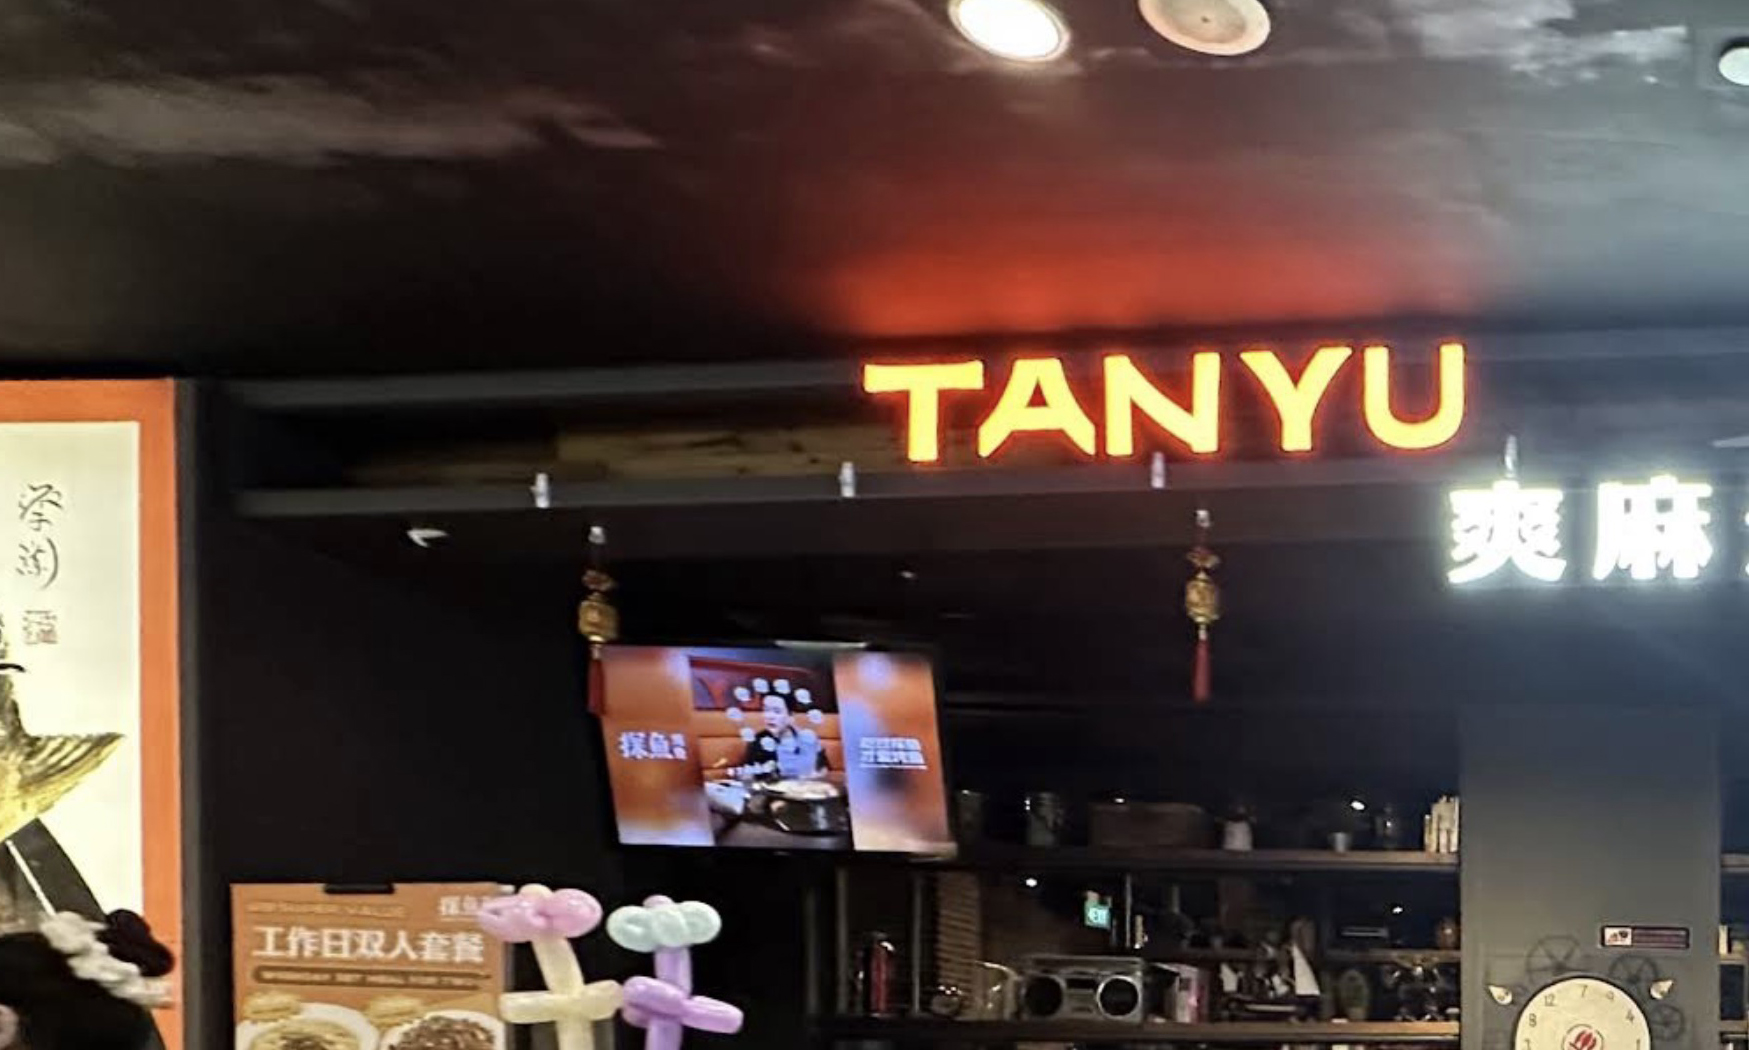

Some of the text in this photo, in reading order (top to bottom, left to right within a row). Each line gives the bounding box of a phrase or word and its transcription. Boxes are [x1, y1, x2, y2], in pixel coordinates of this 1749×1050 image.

[863, 343, 1466, 463] TANYU
[252, 926, 484, 962] 工作日双人套餐
